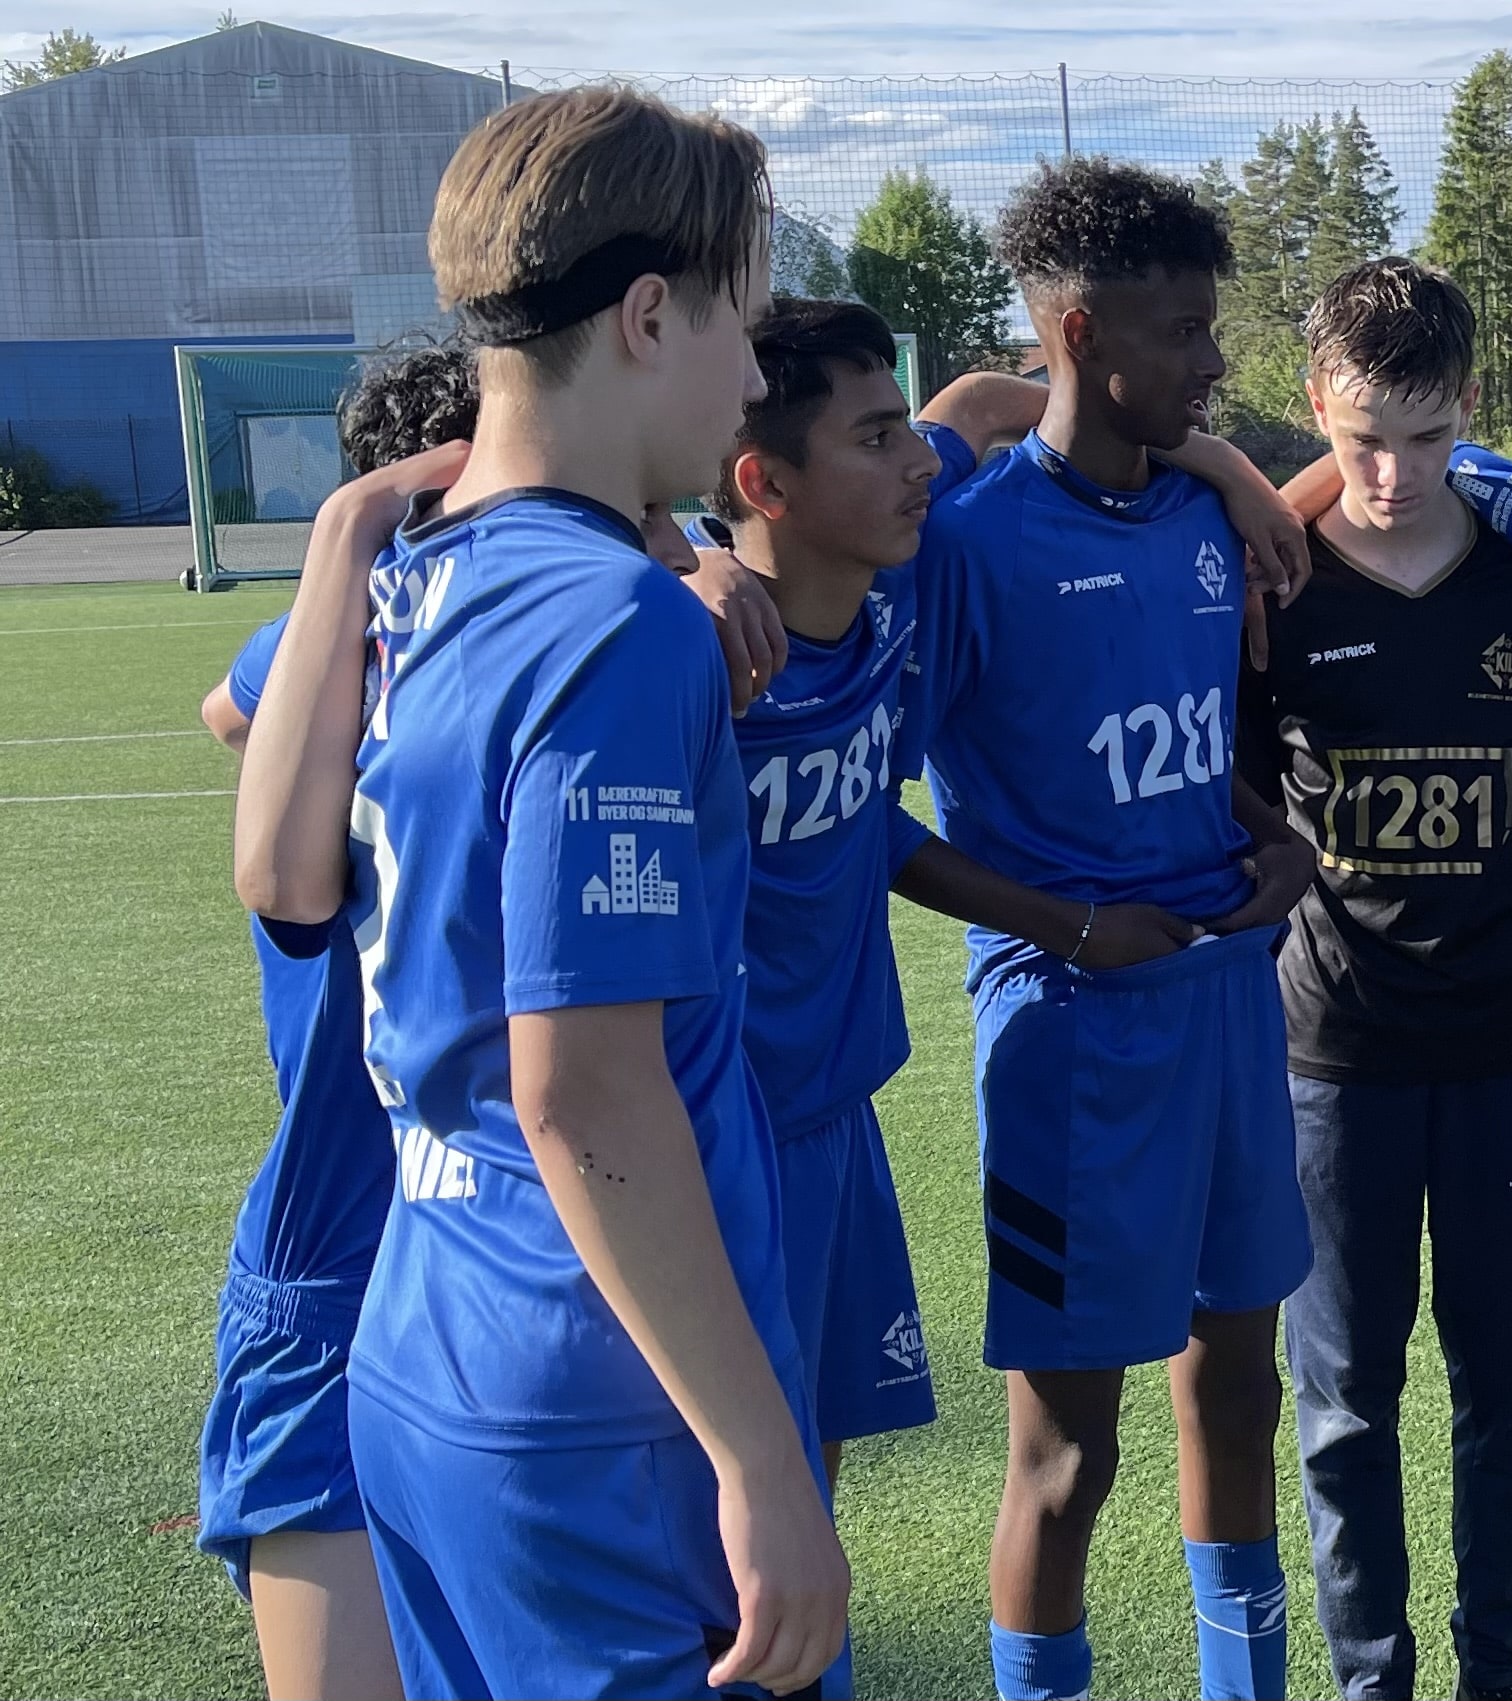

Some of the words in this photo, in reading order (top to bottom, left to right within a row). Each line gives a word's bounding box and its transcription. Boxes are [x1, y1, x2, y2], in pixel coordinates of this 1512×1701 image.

[1073, 572, 1126, 593] PATRICK
[1323, 642, 1377, 662] PATRICK
[1087, 687, 1225, 805] 1281
[748, 701, 892, 845] 1281
[566, 787, 590, 821] 11
[598, 786, 682, 805] BÆREKRAFTIGE
[598, 805, 628, 821] BYER
[629, 805, 646, 821] OG
[646, 805, 695, 824] SAMFUNN
[1346, 774, 1493, 850] 1281
[898, 1328, 924, 1354] KIL
